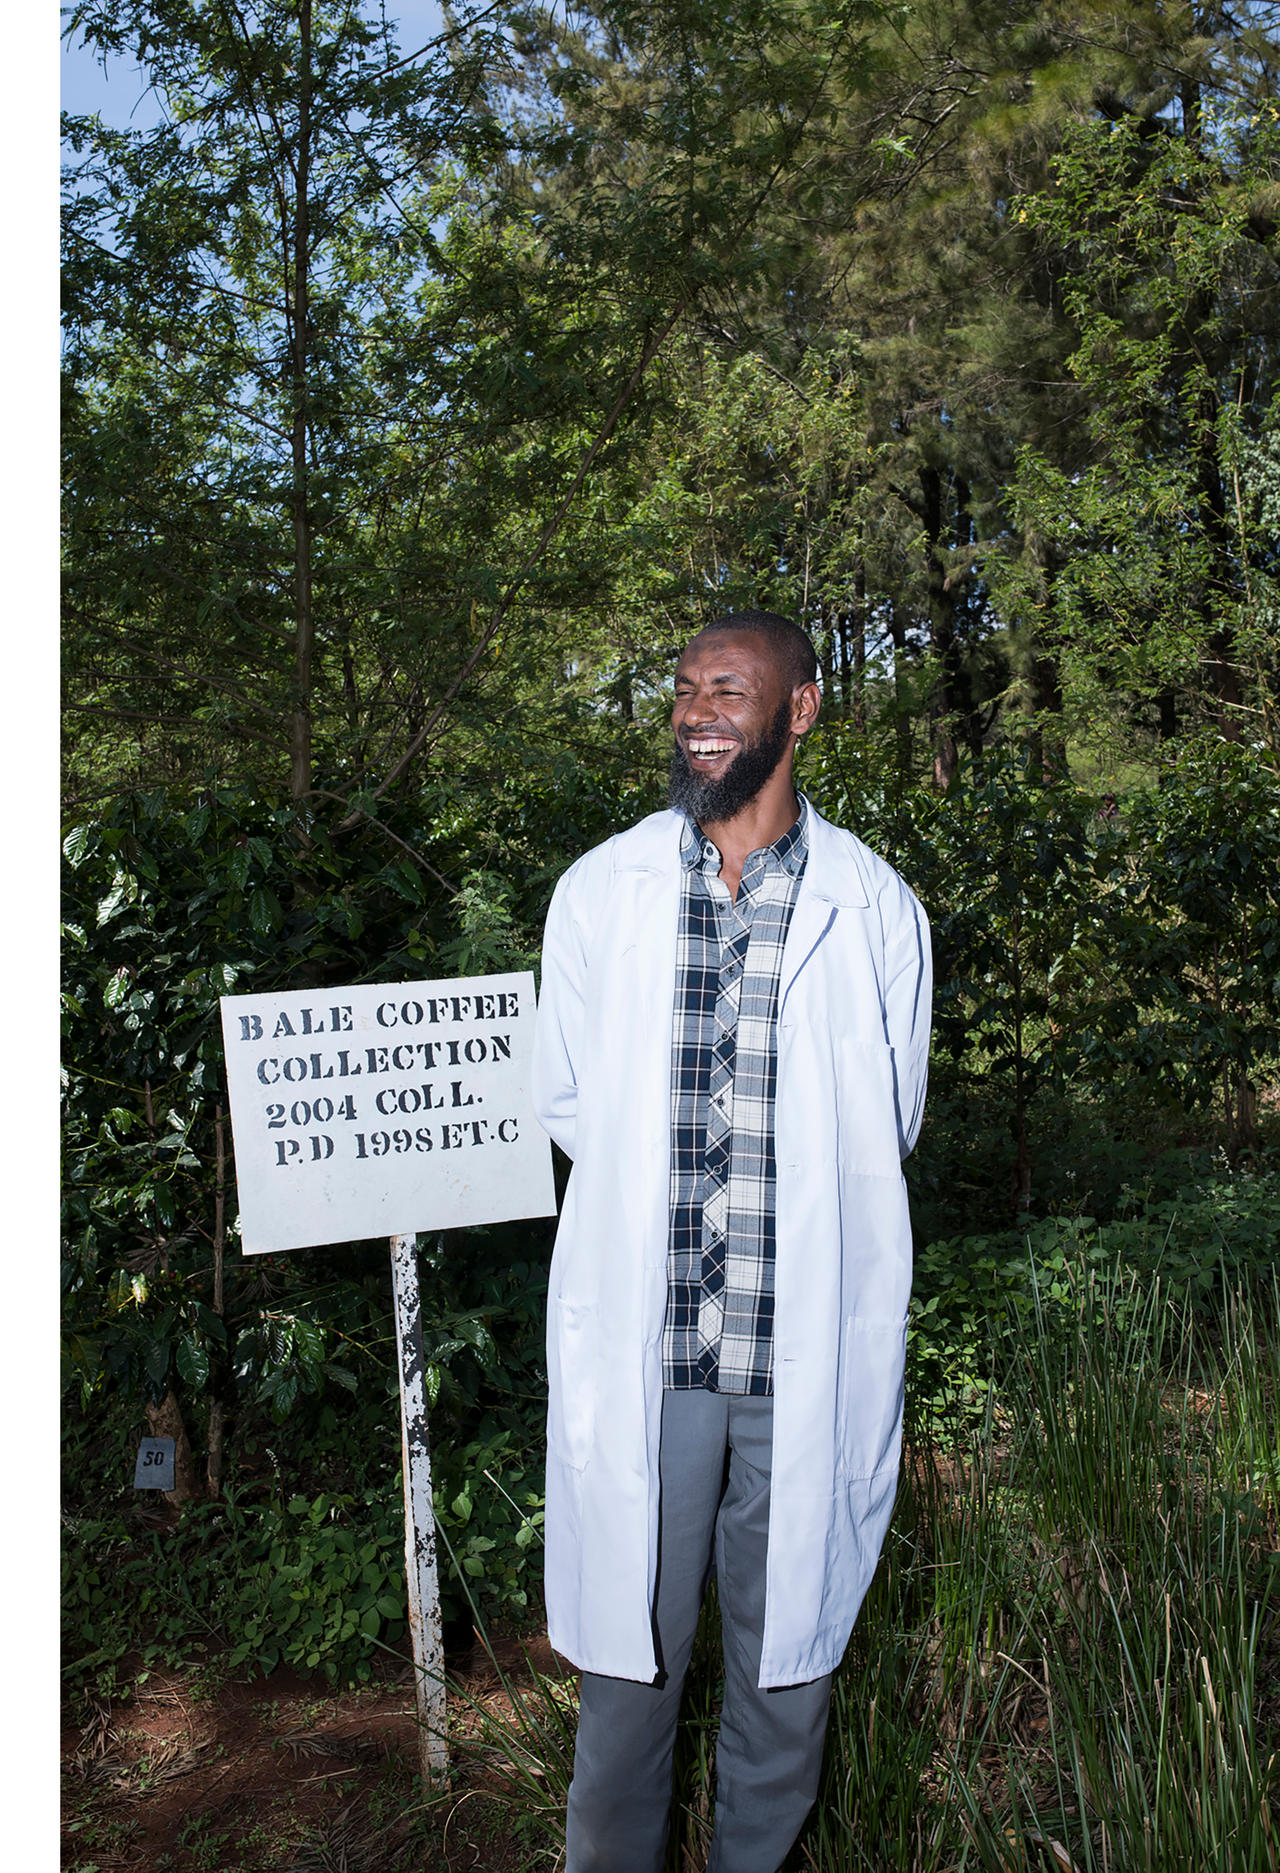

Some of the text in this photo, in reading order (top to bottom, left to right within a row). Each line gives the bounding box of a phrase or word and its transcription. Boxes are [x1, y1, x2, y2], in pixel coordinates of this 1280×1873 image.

[238, 991, 520, 1042] BALE COFFEE
[256, 1034, 512, 1085] COLLECTION
[265, 1080, 484, 1130] 2004 COLL.
[274, 1134, 335, 1166] P.D
[142, 1450, 166, 1467] 50
